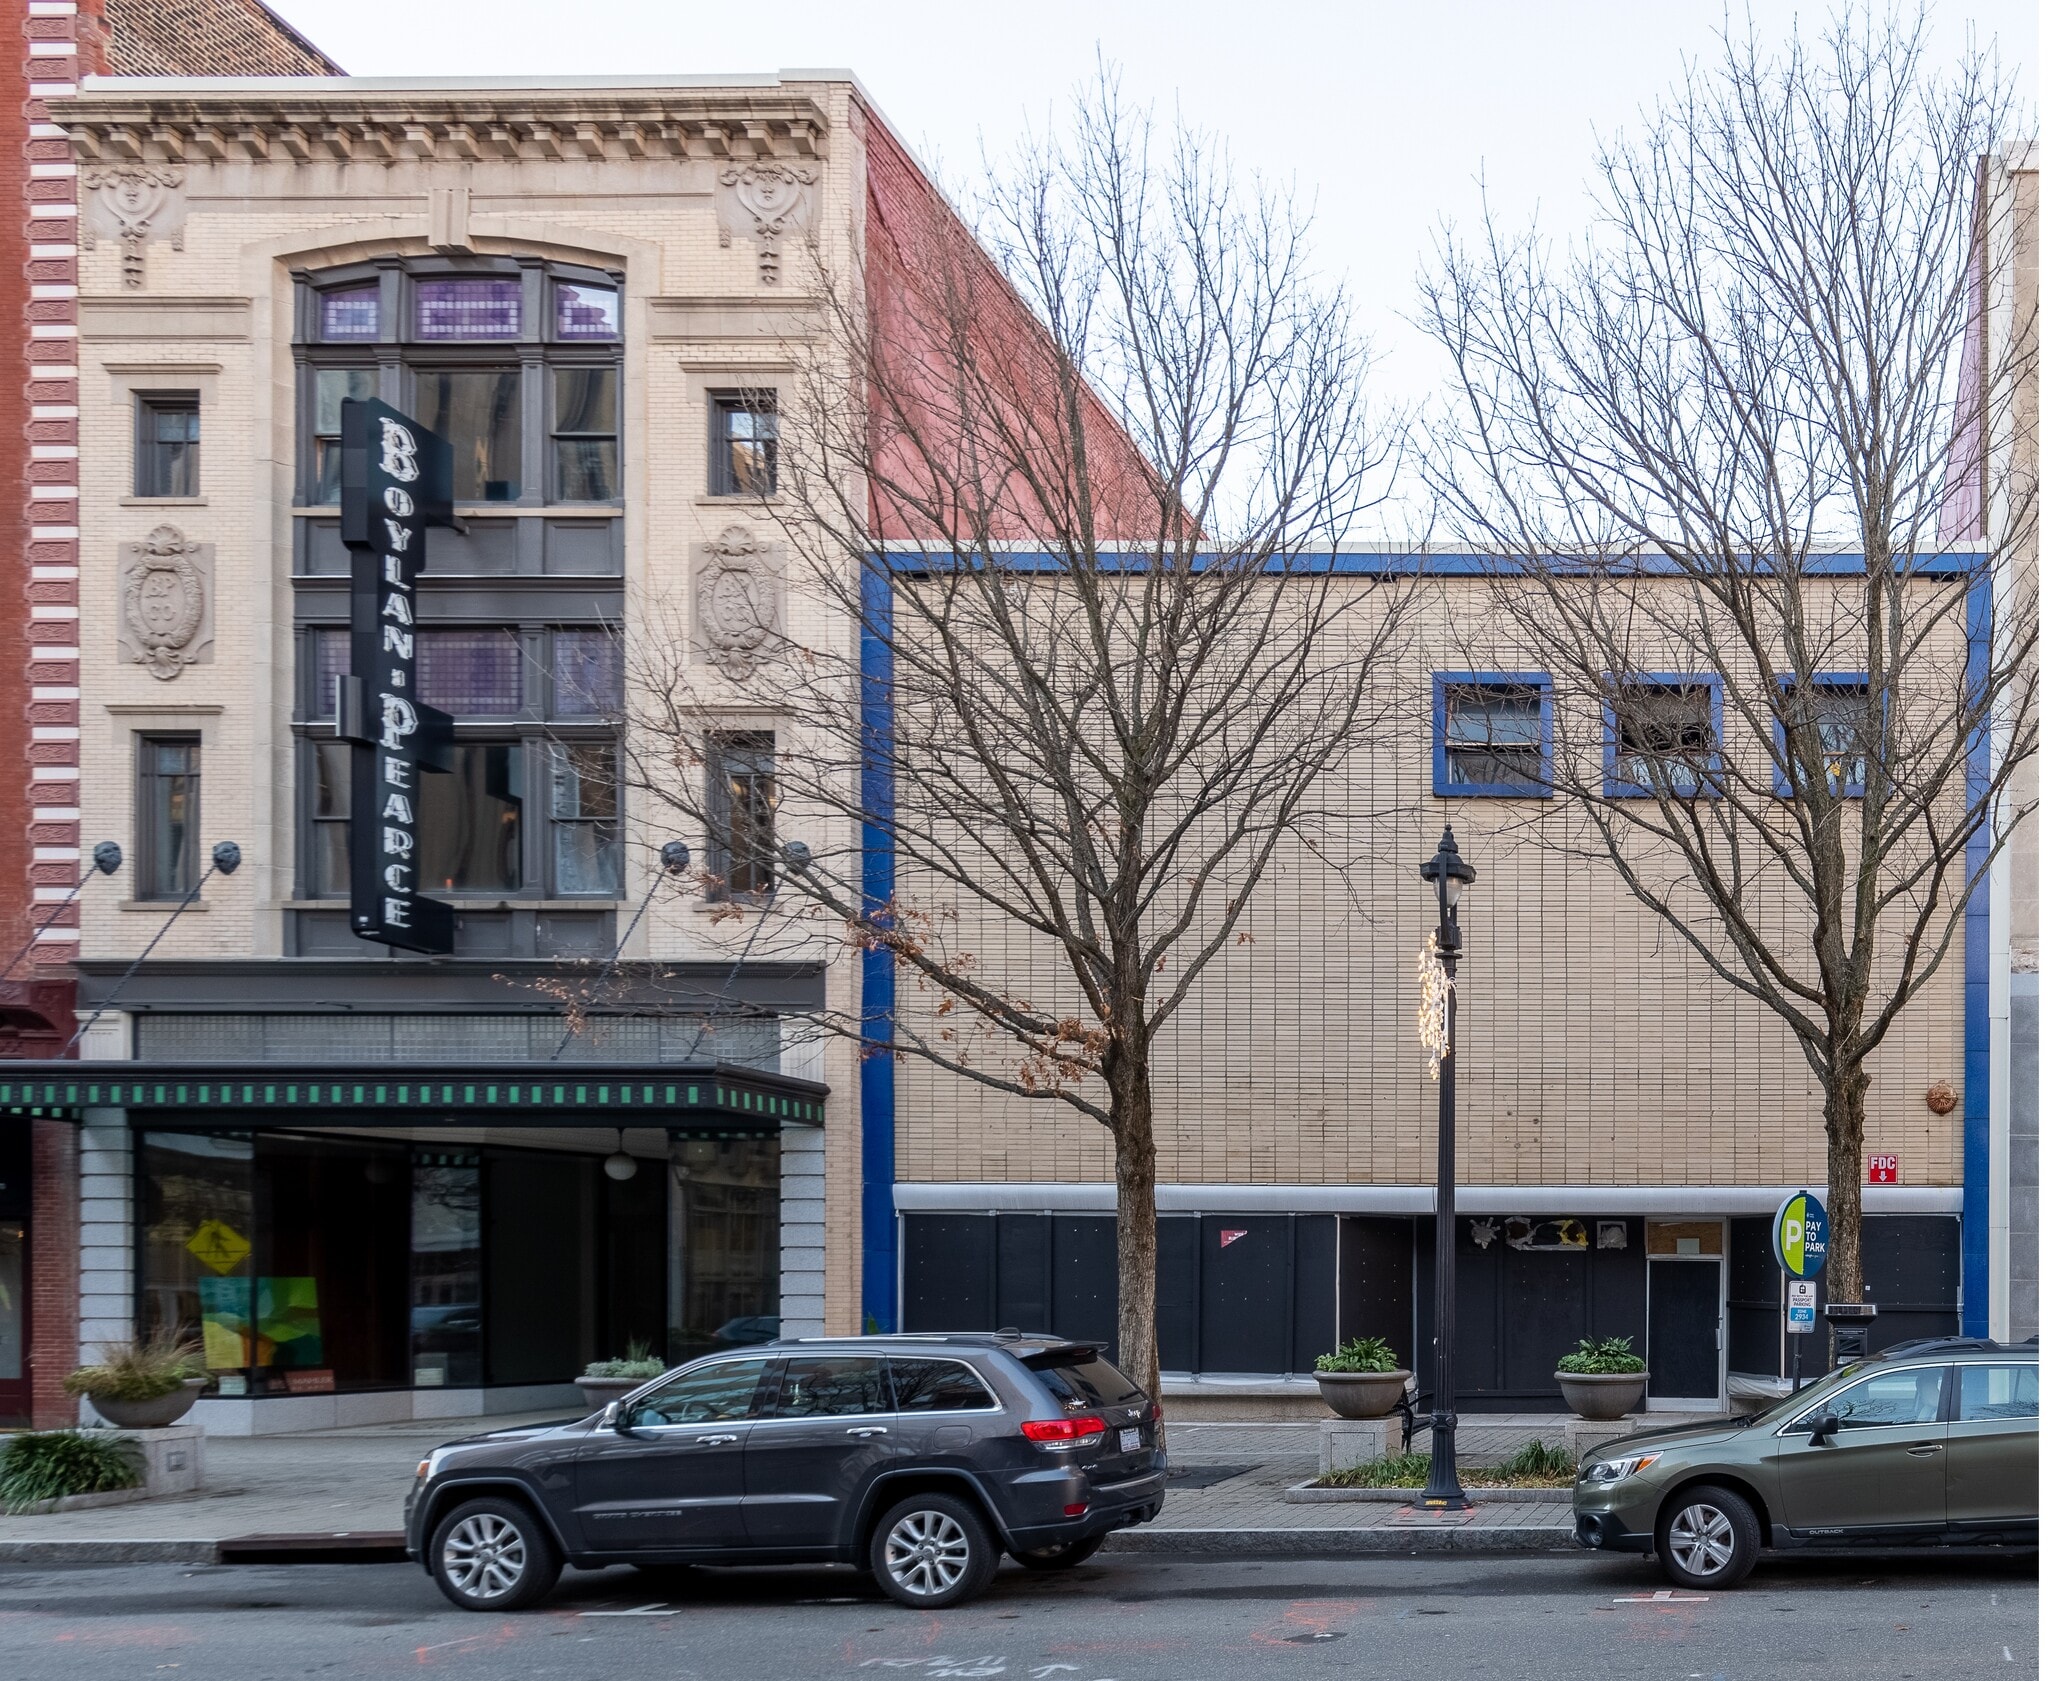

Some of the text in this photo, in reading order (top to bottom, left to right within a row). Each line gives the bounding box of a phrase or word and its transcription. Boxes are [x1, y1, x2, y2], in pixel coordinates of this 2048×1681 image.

[378, 416, 420, 660] BOYLAN
[378, 692, 420, 928] PEARCE
[1870, 1156, 1896, 1170] FDC
[1805, 1221, 1822, 1232] PAY
[1785, 1219, 1803, 1251] P
[1805, 1231, 1817, 1242] TO
[1804, 1242, 1826, 1253] PARK
[1794, 1313, 1809, 1321] 2934
